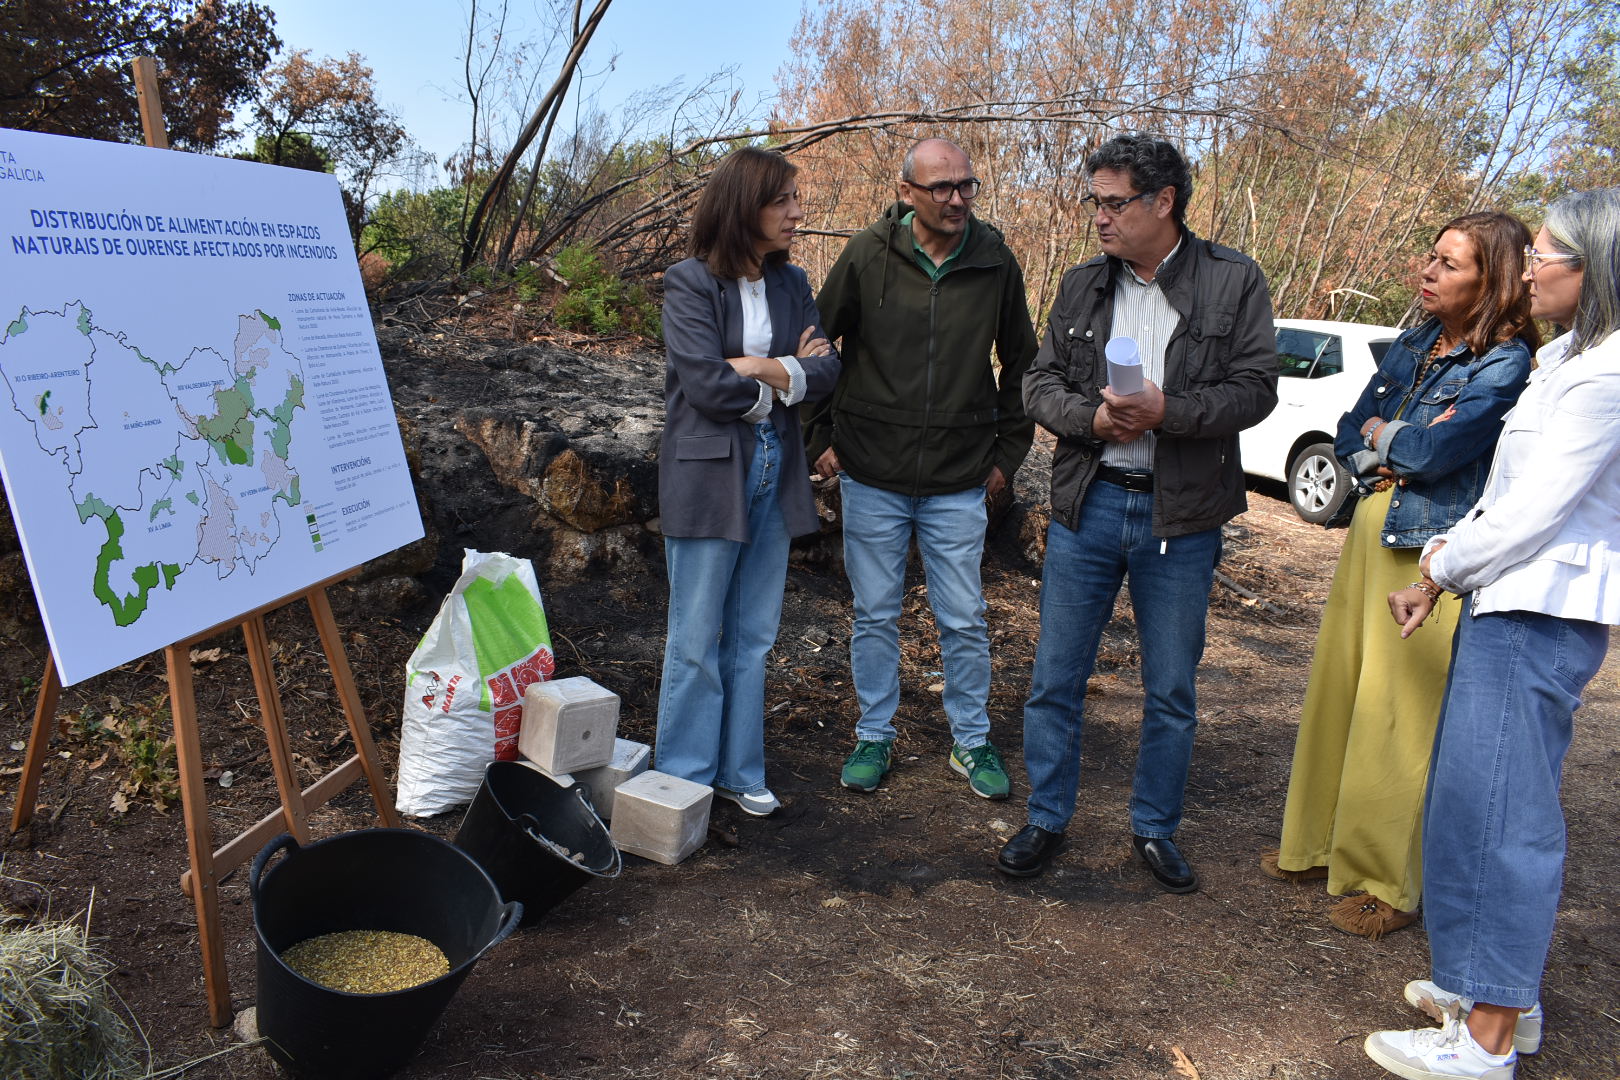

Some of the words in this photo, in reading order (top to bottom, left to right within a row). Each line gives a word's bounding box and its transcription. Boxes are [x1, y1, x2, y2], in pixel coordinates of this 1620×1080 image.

[0, 151, 17, 164] TA
[30, 208, 144, 231] DISTRIBUCIÓN
[145, 216, 166, 232] DE
[169, 216, 260, 237] ALIMENTACIÓN
[262, 222, 277, 239] EN
[278, 223, 321, 240] ESPAZOS
[12, 235, 100, 255] NATURAIS
[102, 238, 124, 255] DE
[126, 239, 191, 256] OURENSE
[194, 240, 262, 258] AFECTADOS
[264, 243, 286, 259] POR
[287, 244, 338, 260] INCENDIOS
[288, 293, 308, 302] ZONAS
[308, 292, 315, 301] DE
[316, 290, 346, 301] ACTUACIÓN
[331, 455, 372, 475] INTERVENCIÓNS
[341, 498, 371, 516] EXECUCIÓN
